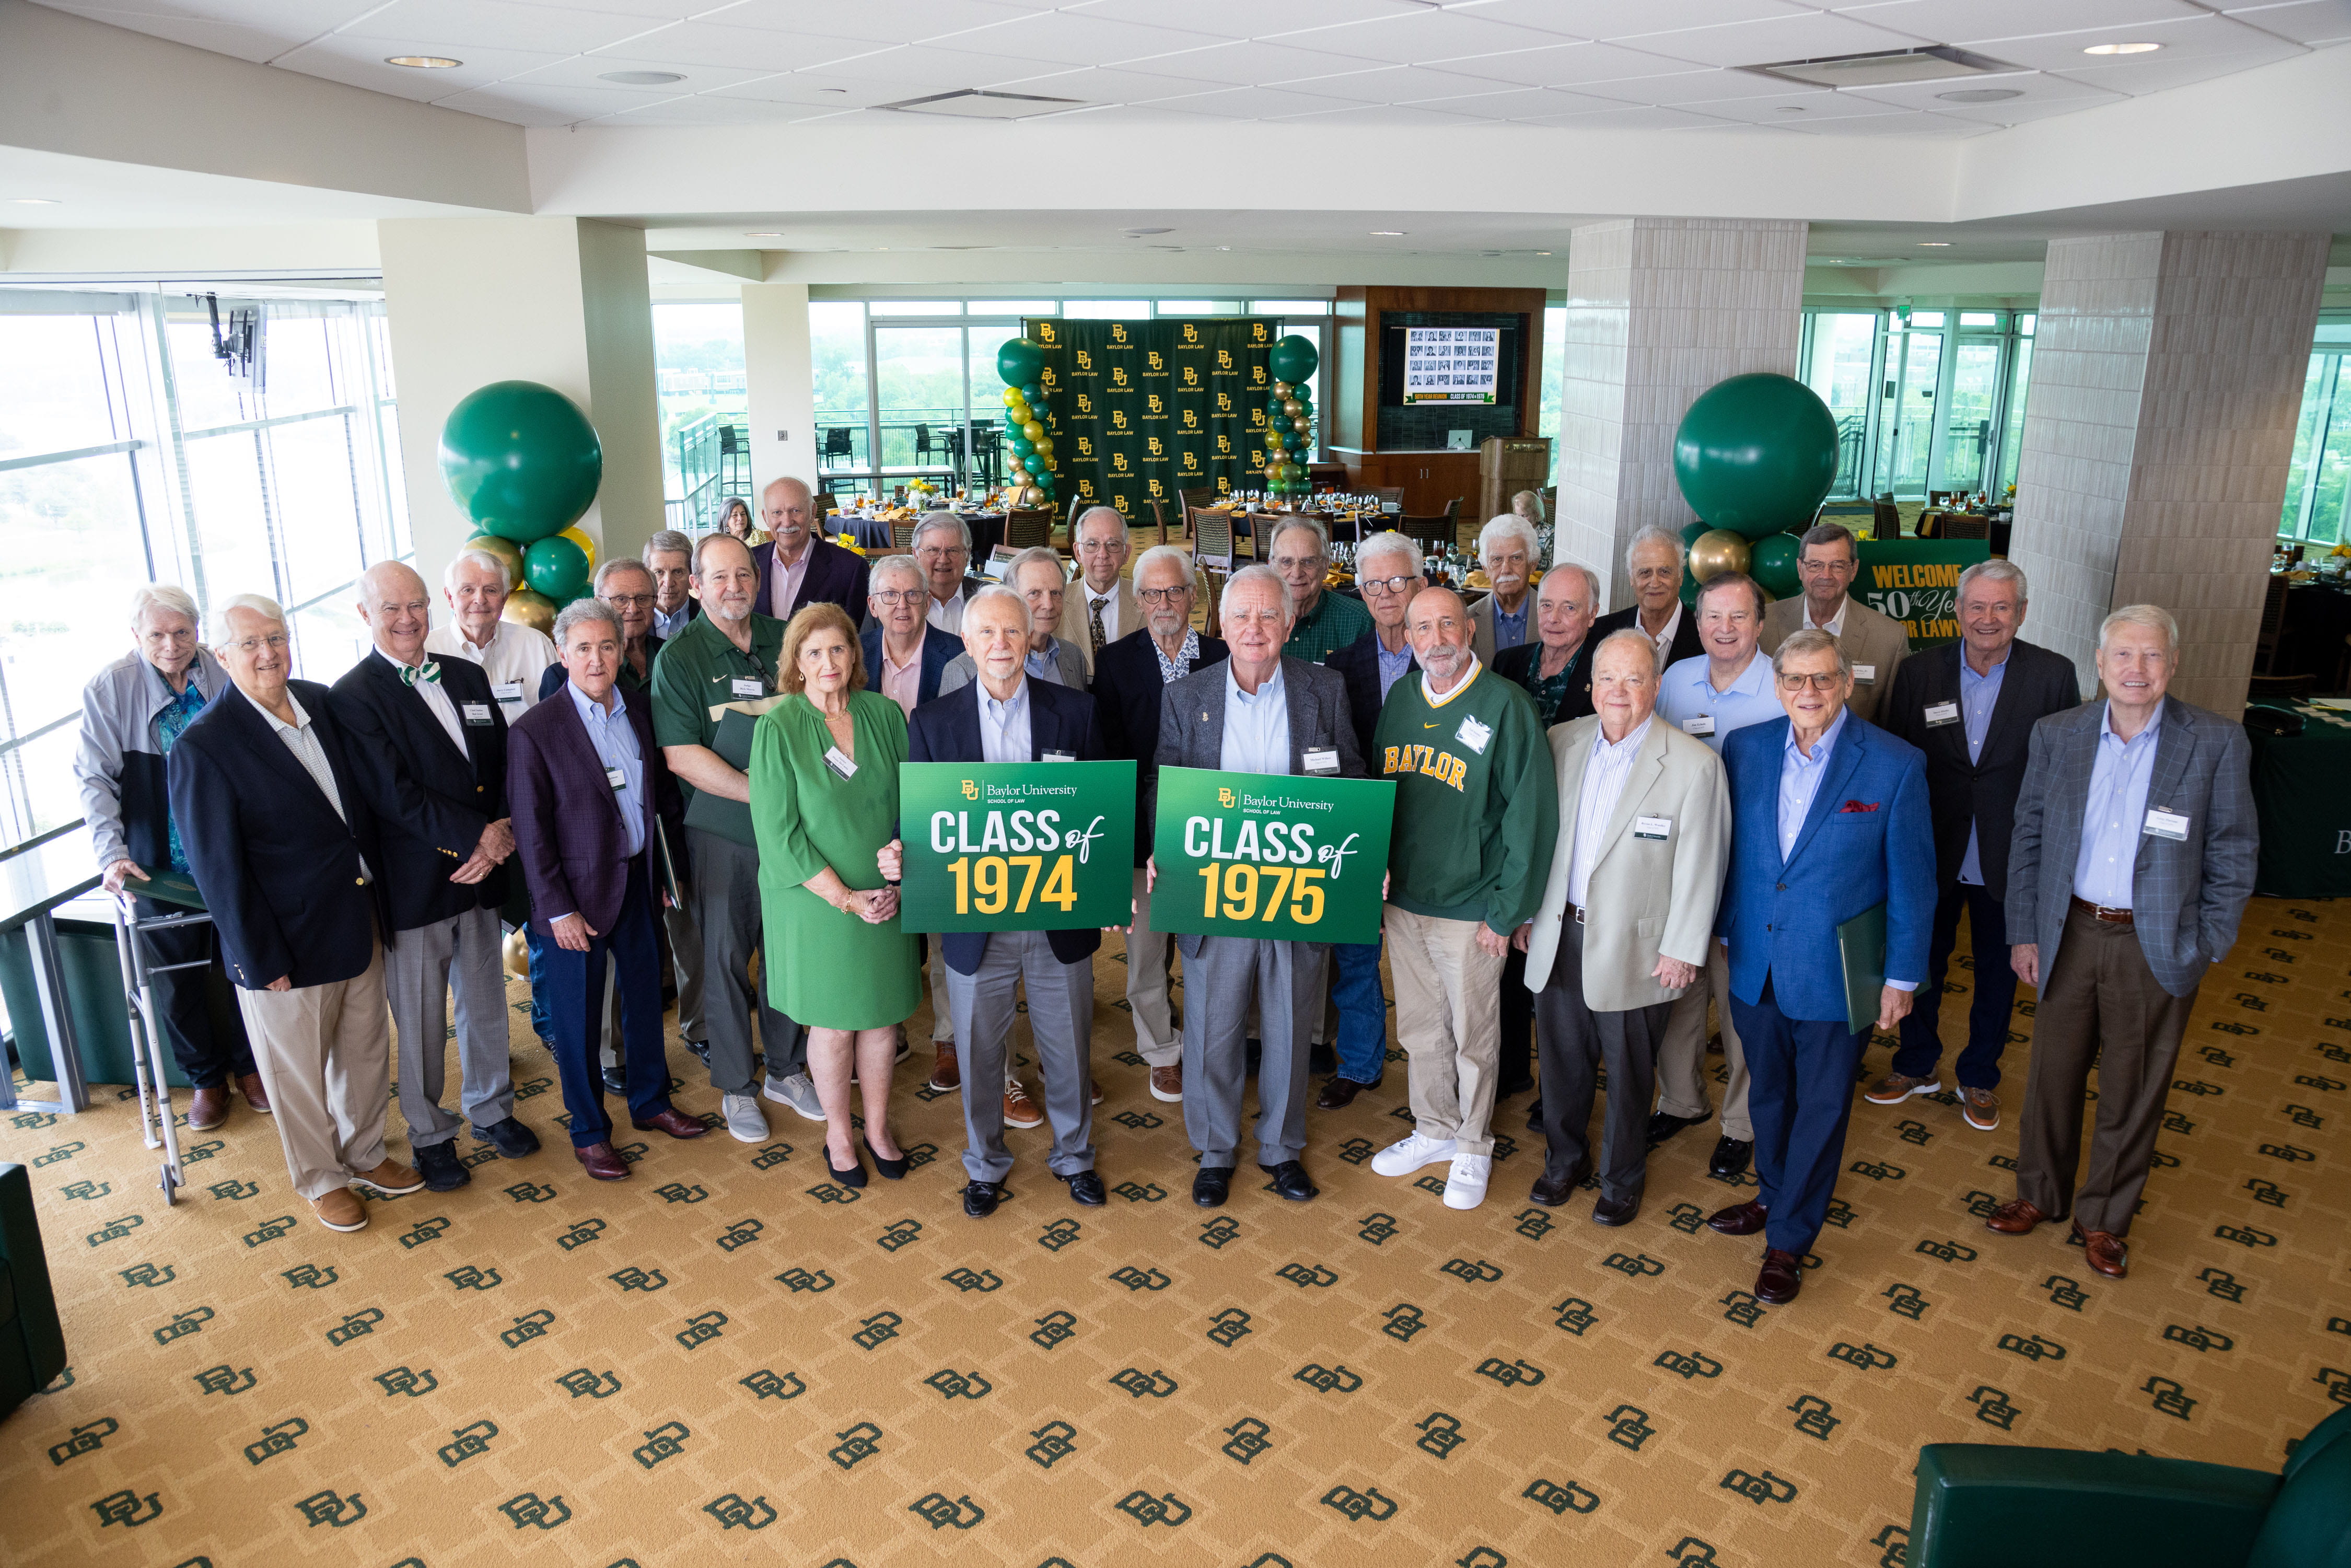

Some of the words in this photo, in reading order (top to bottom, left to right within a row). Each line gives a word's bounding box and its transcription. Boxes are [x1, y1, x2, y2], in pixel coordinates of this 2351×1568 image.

[1872, 564, 1962, 588] WELCOME
[1921, 620, 1962, 637] LAWY
[1383, 744, 1467, 792] BAYLOR
[961, 780, 979, 800] BU
[987, 784, 1021, 798] Baylor
[1022, 784, 1077, 797] University
[1218, 787, 1236, 808] BU
[1243, 794, 1277, 808] Baylor
[1279, 797, 1334, 812] University
[931, 810, 1060, 853] CLASS
[1065, 815, 1105, 864] of
[1185, 816, 1314, 864] CLASS
[1318, 833, 1359, 879] of
[947, 855, 1078, 914] 1974
[1198, 862, 1326, 924] 1975
